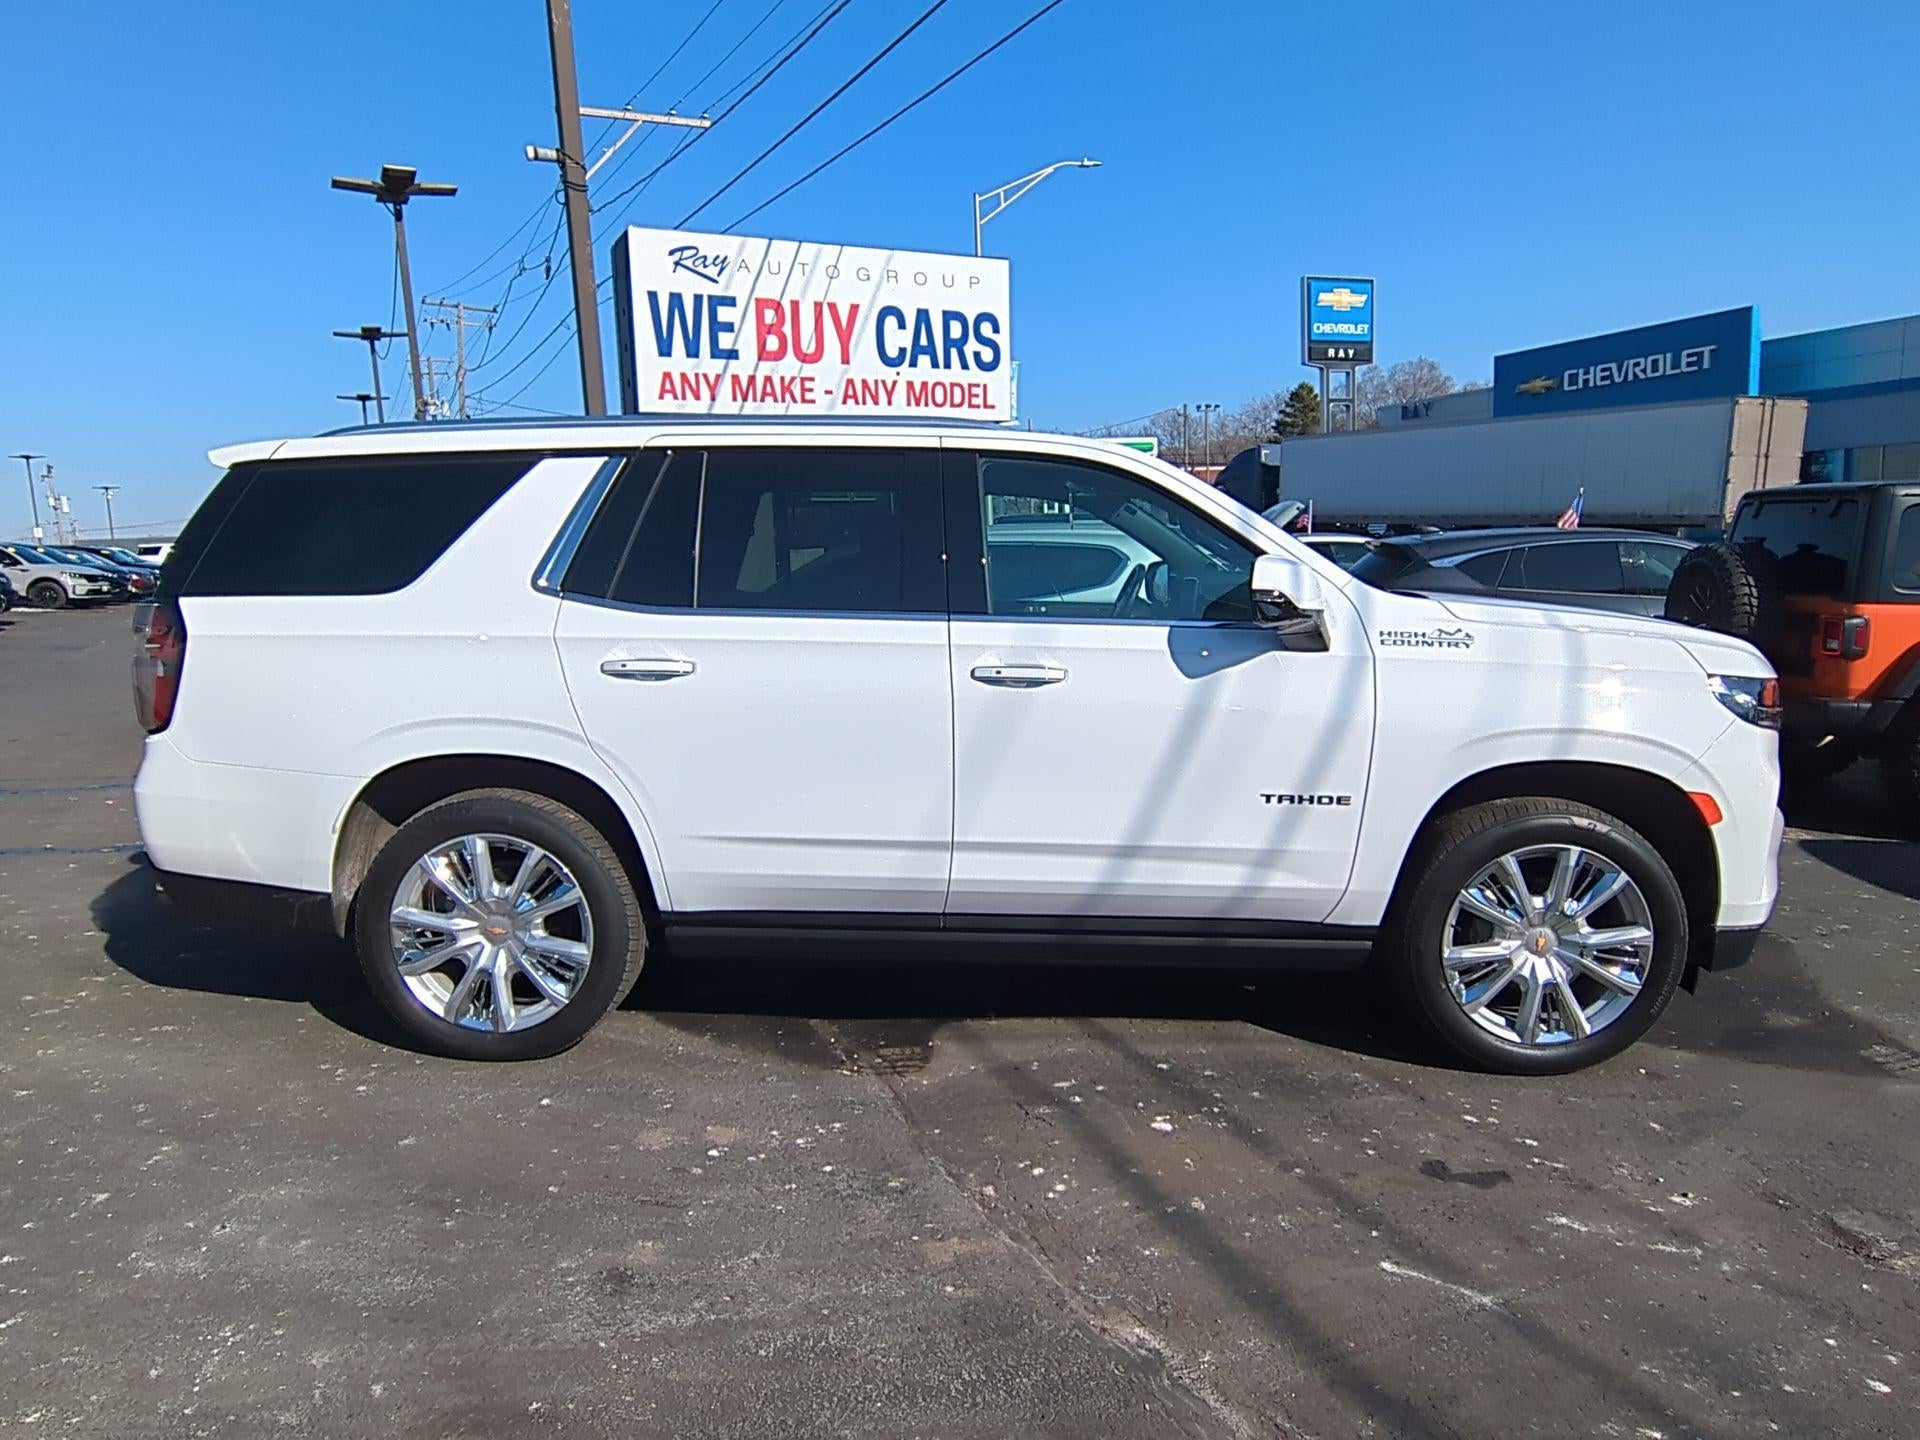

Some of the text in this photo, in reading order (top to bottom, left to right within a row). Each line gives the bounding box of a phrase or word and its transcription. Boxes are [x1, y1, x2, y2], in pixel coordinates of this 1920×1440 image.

[668, 245, 731, 284] Ray
[646, 290, 1001, 371] WE BUY CARS
[1313, 322, 1369, 334] CHEVROLET
[1328, 348, 1354, 358] RAY
[1563, 345, 1717, 391] CHEVROLET
[658, 371, 722, 400] ANY
[732, 374, 816, 404] MAKE
[841, 378, 898, 407] ANY
[906, 381, 995, 409] MODEL
[1379, 630, 1427, 639] HIGH
[1380, 638, 1475, 649] COUNTRY
[1260, 793, 1352, 806] TAHOE
